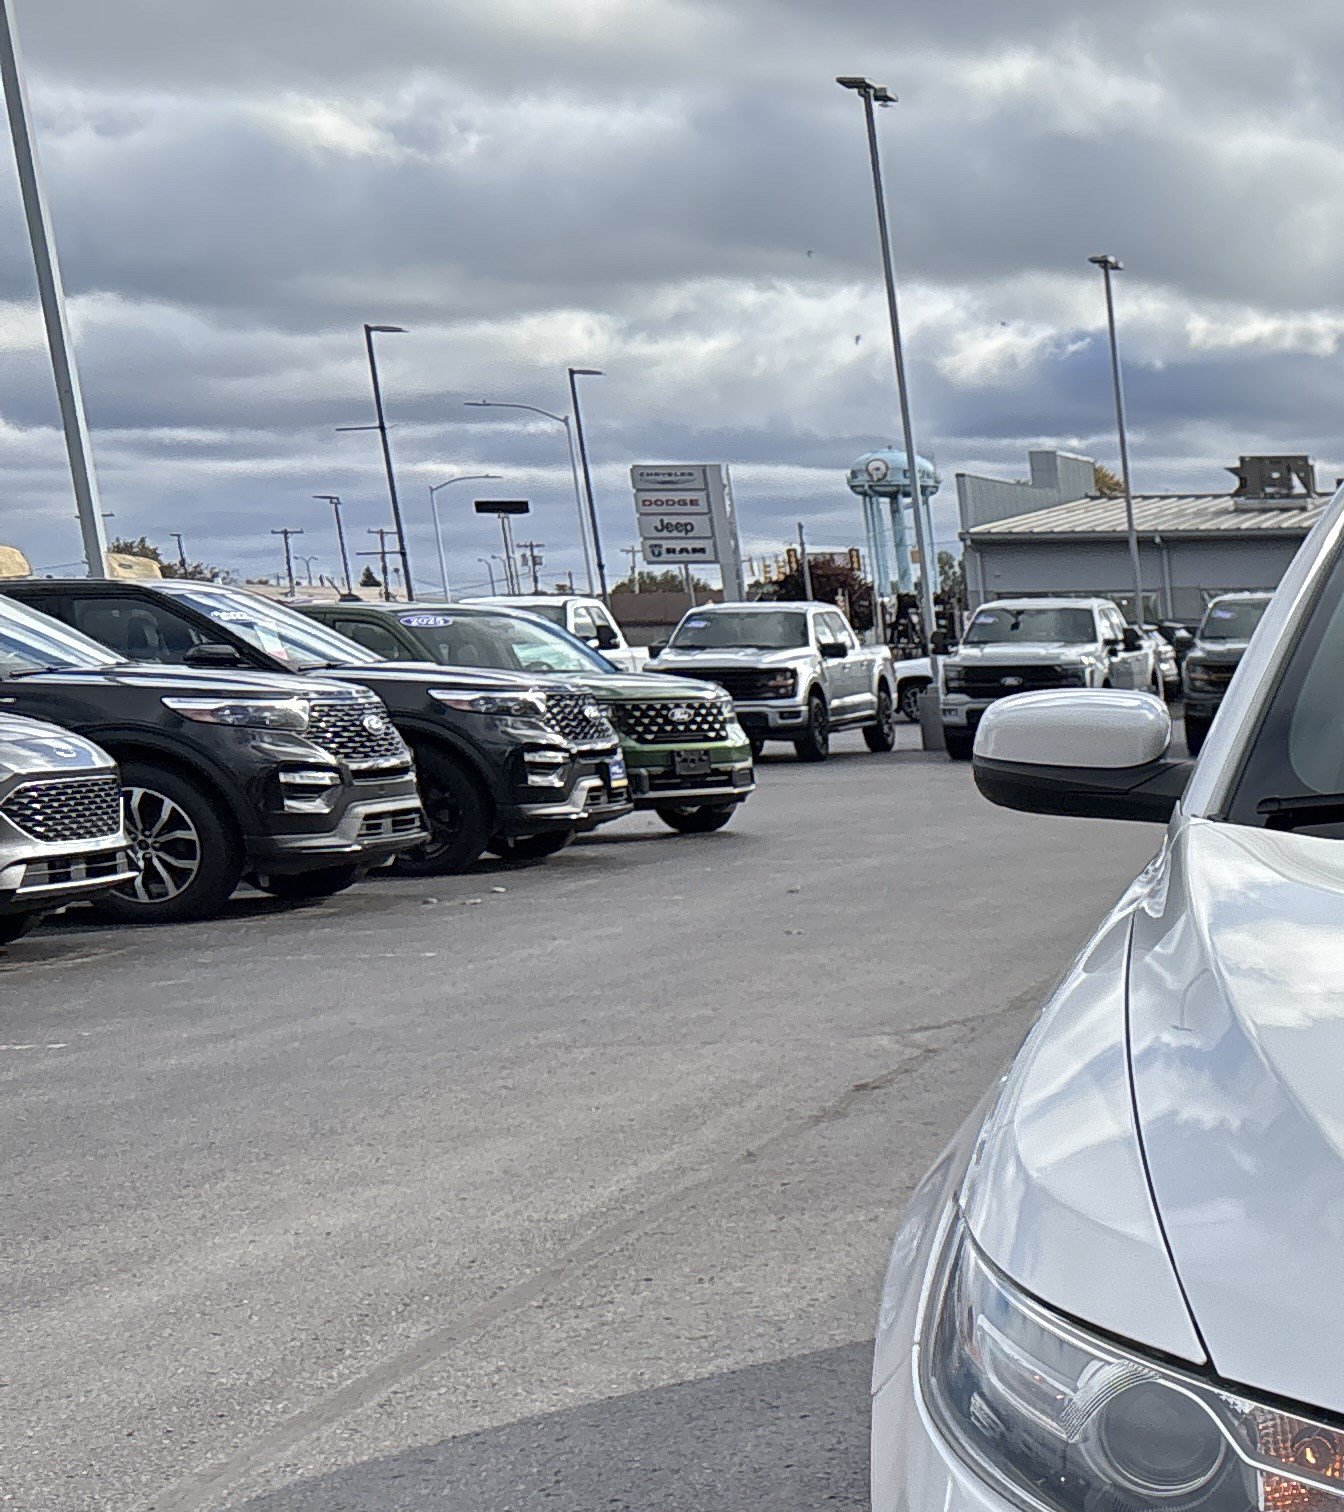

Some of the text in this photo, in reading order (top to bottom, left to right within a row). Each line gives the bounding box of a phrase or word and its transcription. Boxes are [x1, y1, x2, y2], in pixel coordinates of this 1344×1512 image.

[641, 498, 700, 508] DODGE
[653, 518, 695, 536] Jeep
[665, 547, 707, 556] RAM
